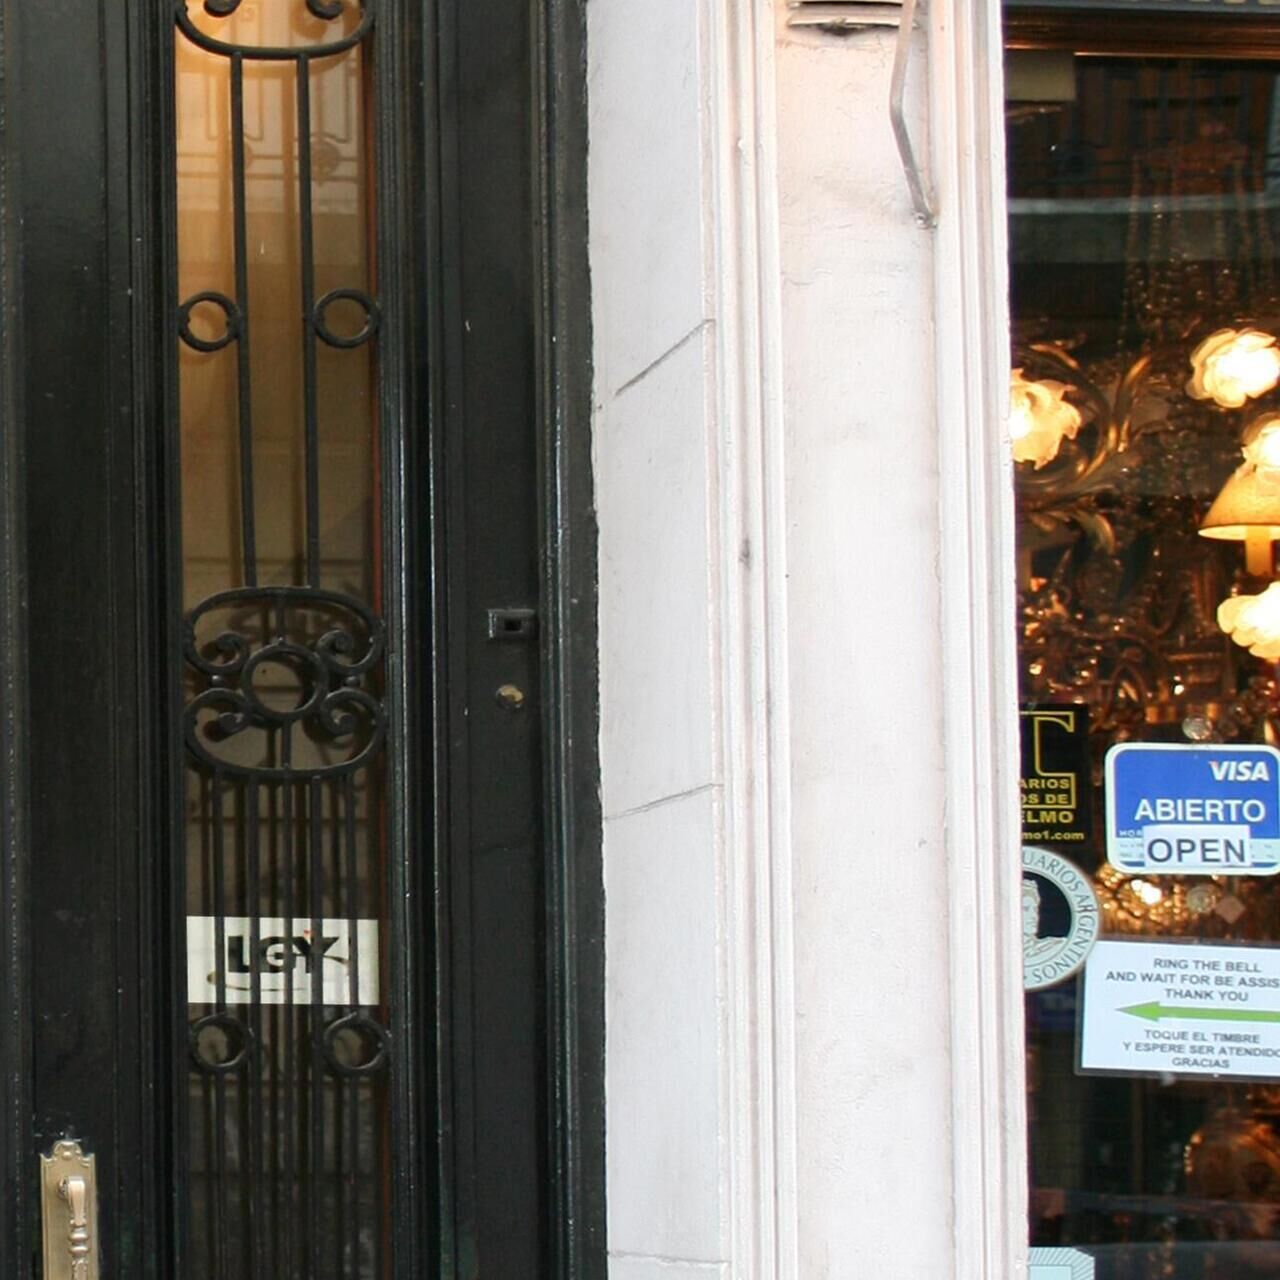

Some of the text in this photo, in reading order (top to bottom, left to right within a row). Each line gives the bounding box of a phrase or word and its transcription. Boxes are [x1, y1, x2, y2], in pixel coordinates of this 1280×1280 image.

[1208, 760, 1269, 781] VISA
[1045, 794, 1069, 804] DE
[1134, 798, 1266, 823] ABIERTO
[1147, 838, 1246, 863] OPEN
[1032, 893, 1097, 984] ARGENTINOS
[227, 935, 340, 974] LGY
[1153, 958, 1261, 973] RING THE BELL
[1106, 970, 1136, 982] AND
[1140, 972, 1176, 984] WAIT
[1180, 974, 1210, 986] FOR
[1214, 975, 1233, 986] BE
[1165, 988, 1249, 1002] THANK YOU
[1145, 1029, 1261, 1044] TOQUE EL TIMBRE
[1123, 1042, 1132, 1051] Y
[1135, 1042, 1185, 1054] ESPERE
[1189, 1044, 1215, 1055] SER
[1171, 1057, 1230, 1069] GRACIAS
